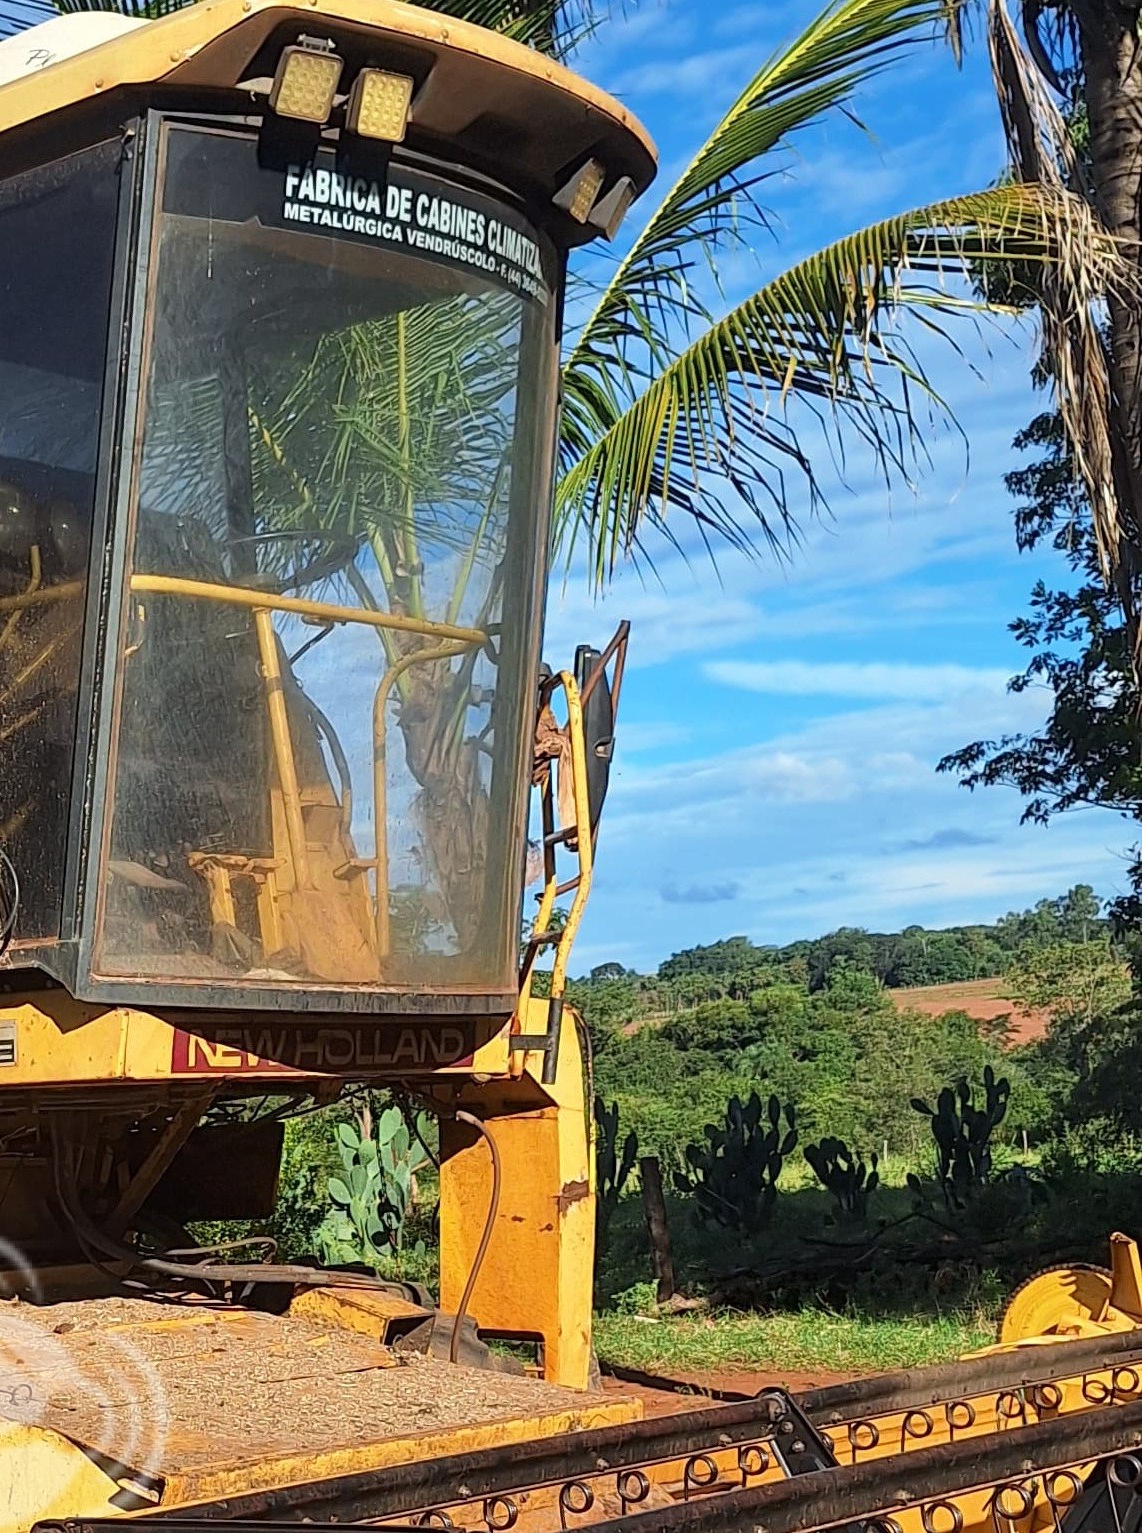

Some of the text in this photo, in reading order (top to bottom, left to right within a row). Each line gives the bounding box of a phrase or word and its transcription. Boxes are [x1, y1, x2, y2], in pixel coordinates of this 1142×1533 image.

[284, 201, 403, 242] METALÚRGICA
[406, 228, 496, 272] VENDRÚSCOLO
[285, 161, 381, 215] FÁBRICA
[386, 185, 412, 223] DE
[417, 193, 486, 246] CABINES
[188, 1028, 464, 1068] NEW HOLLAND
